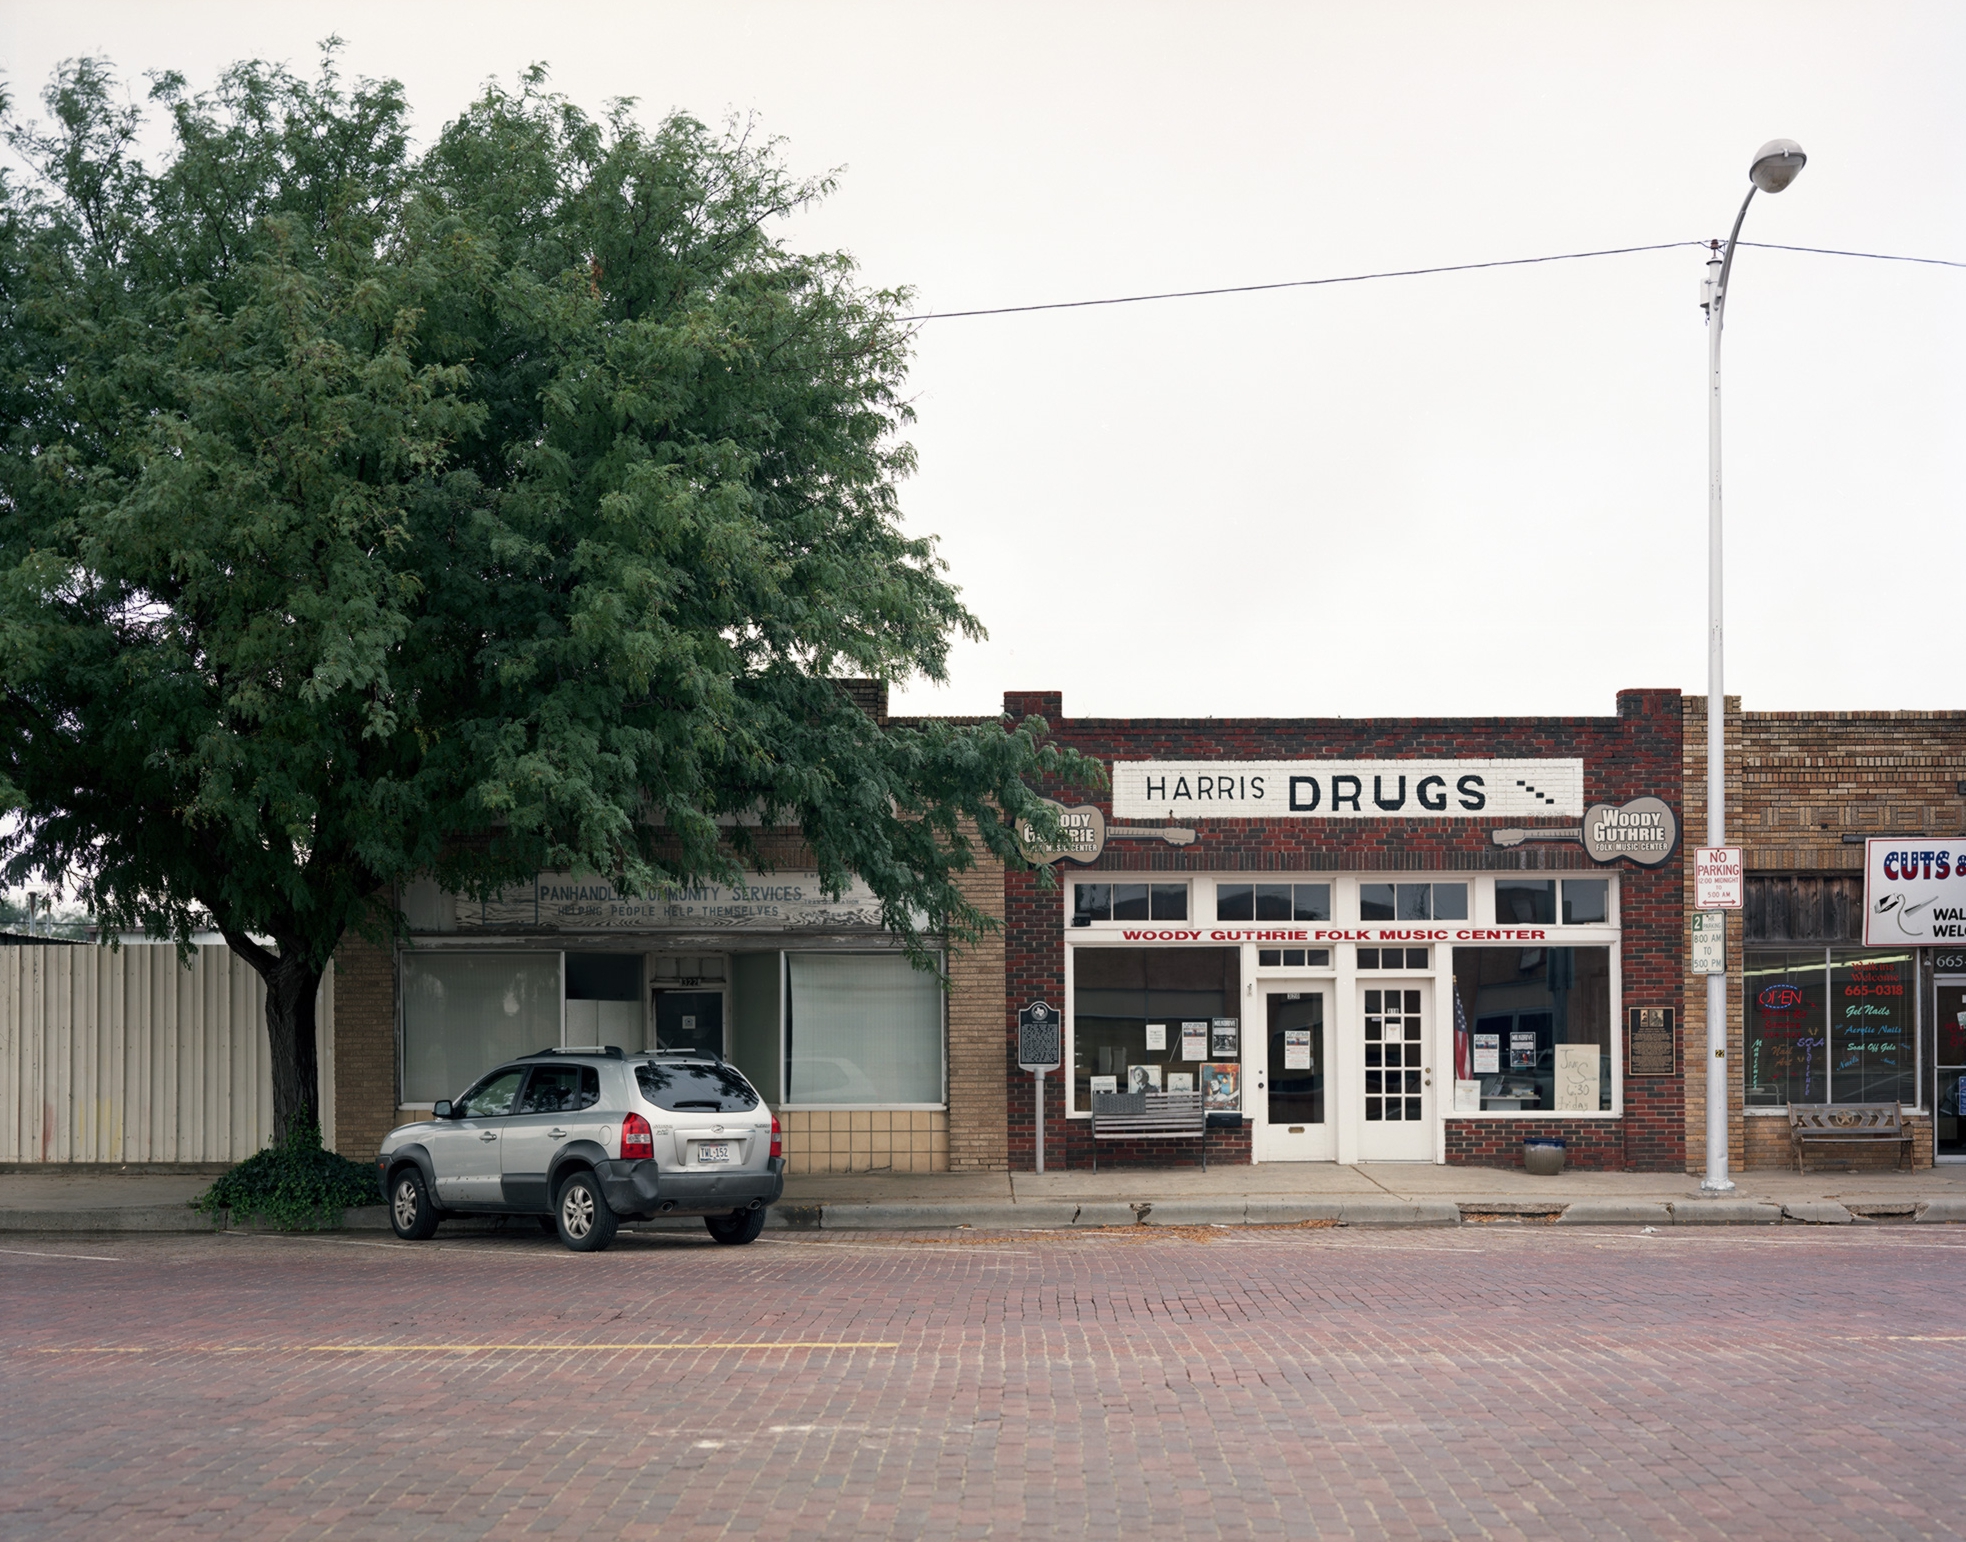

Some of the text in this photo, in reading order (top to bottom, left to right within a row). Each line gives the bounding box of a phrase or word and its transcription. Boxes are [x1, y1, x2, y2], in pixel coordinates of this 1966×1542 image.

[1146, 774, 1486, 812] HARRIS DRUGS
[1602, 809, 1661, 827] WOODY
[1593, 822, 1665, 842] GUTHRIE
[1071, 844, 1098, 852] CENTER
[1596, 843, 1668, 852] FOLK MUSIC CENTER
[1709, 851, 1727, 863] NO
[1697, 864, 1740, 876] PARKING
[1883, 851, 1951, 881] CUTS
[1714, 876, 1739, 884] MIDNIGHT
[732, 886, 802, 901] SERVICES
[558, 906, 778, 917] HELPING PEOPLE HELP THEMSELVES
[1694, 916, 1701, 929] 2
[1122, 930, 1545, 941] WOODY GUTHRIE FOLK MUSIC CENTER
[1933, 925, 1966, 937] WEL
[1711, 934, 1721, 942] AM
[1703, 946, 1712, 955] TO
[1711, 959, 1721, 968] PM
[1850, 972, 1899, 982] Welcome
[1845, 985, 1904, 996] 665-0318
[1759, 990, 1802, 1004] OPEN
[1846, 1005, 1890, 1018] Gel Nails
[1844, 1025, 1875, 1036] Acrylic
[1878, 1025, 1901, 1034] Nails
[1847, 1043, 1865, 1051] Soak
[1867, 1043, 1879, 1052] Off
[1880, 1043, 1896, 1053] Gels
